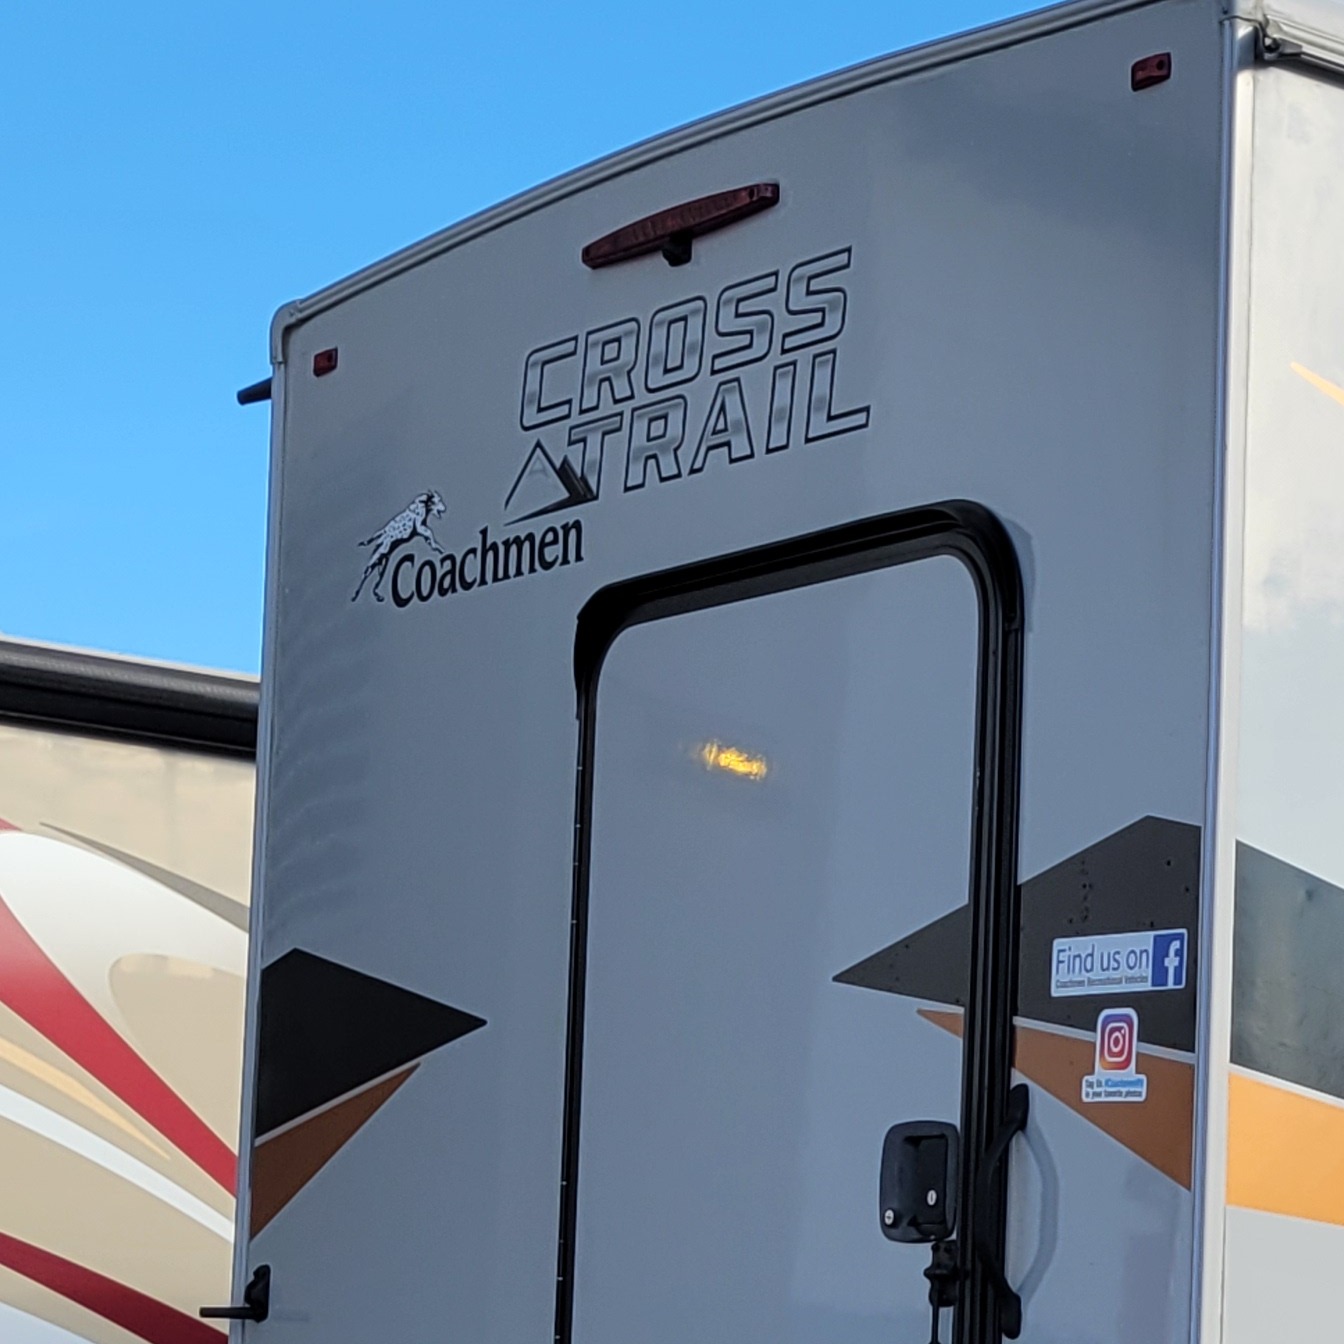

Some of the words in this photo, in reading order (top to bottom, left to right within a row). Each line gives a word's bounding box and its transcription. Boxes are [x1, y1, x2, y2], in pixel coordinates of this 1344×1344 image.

[520, 246, 853, 432] CROSS
[566, 347, 872, 502] TRAIL
[390, 518, 585, 609] Coachmen
[1055, 942, 1096, 976] Find
[1100, 950, 1121, 973] us
[1126, 947, 1150, 971] on
